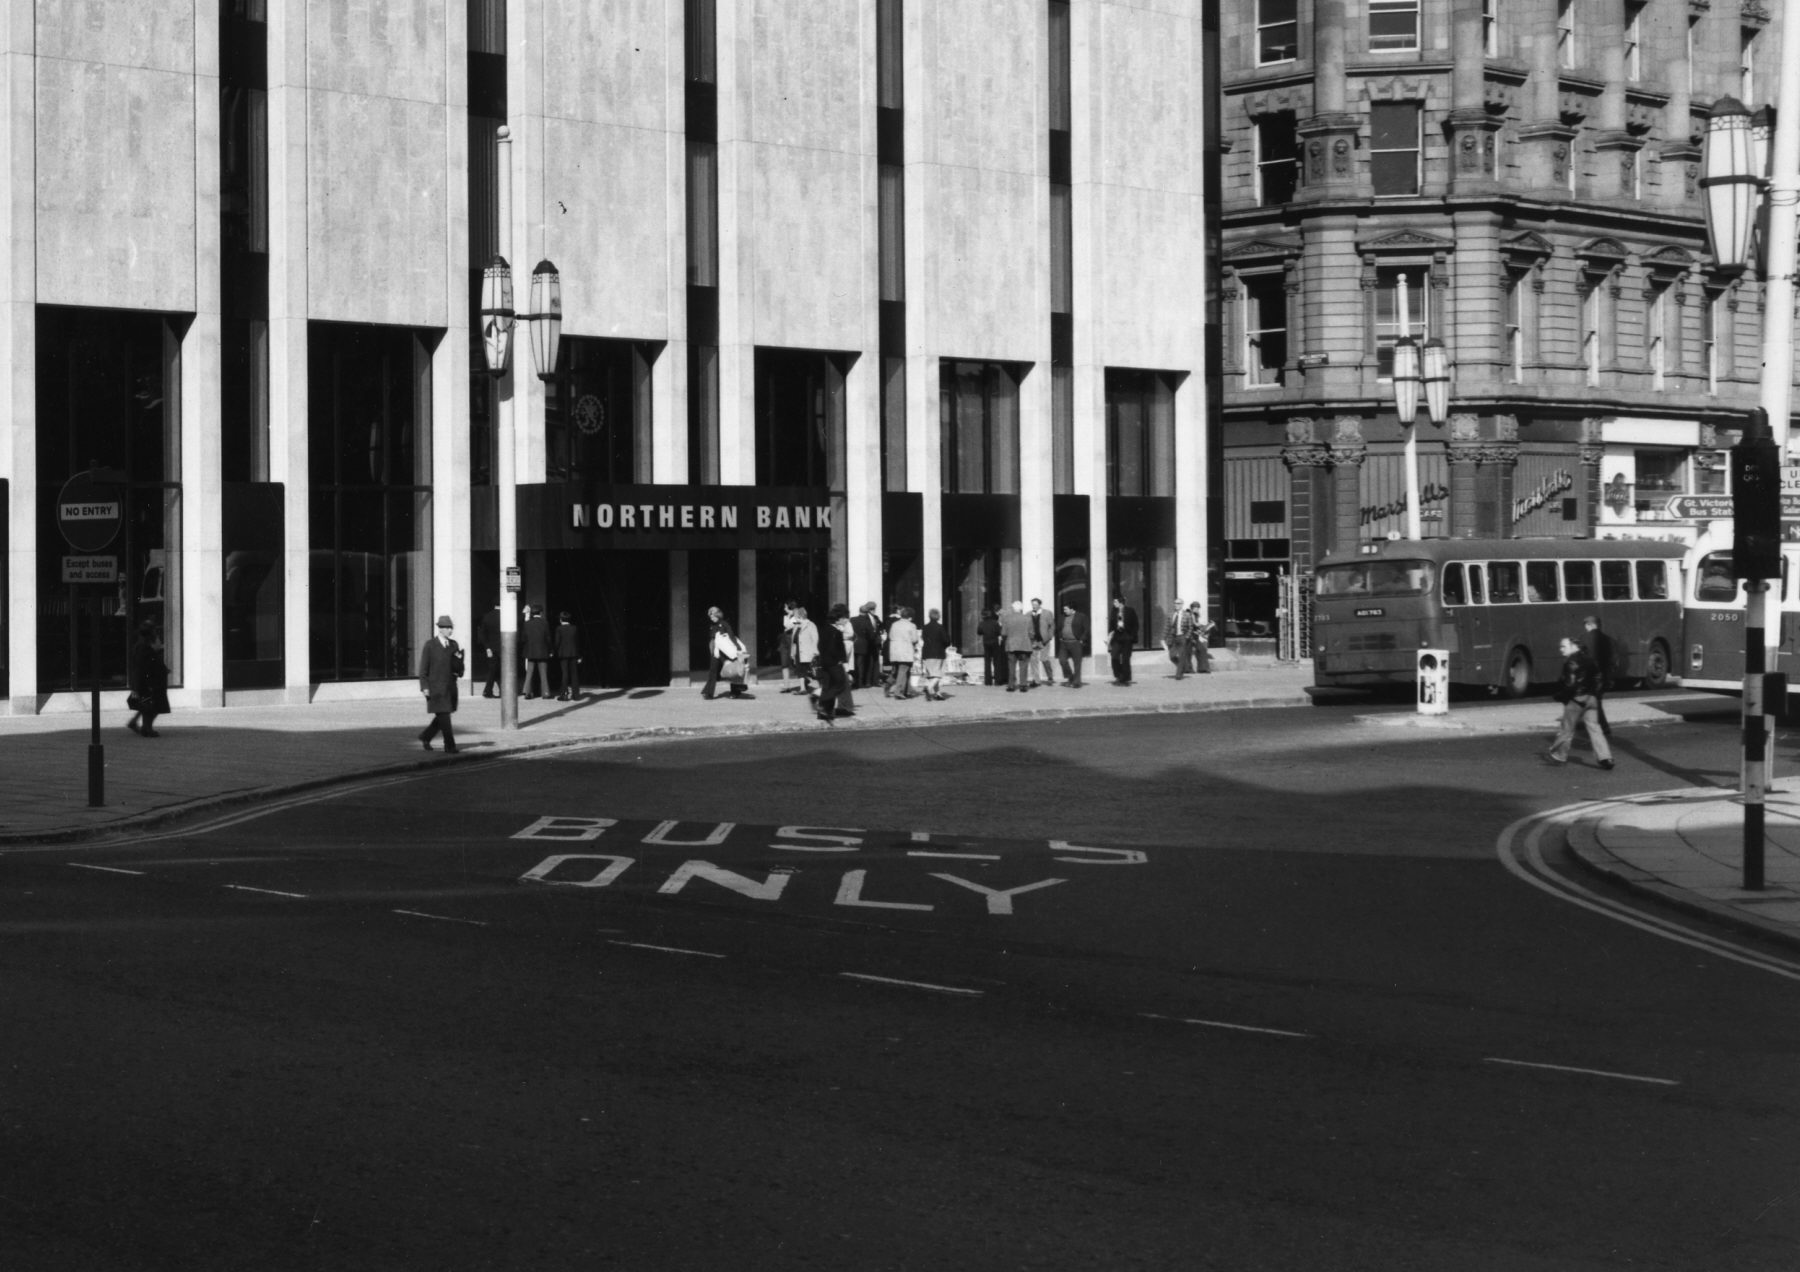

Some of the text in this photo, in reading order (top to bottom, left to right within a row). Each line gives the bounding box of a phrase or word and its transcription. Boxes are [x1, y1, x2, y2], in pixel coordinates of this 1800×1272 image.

[1360, 482, 1448, 526] Marslls
[66, 506, 112, 516] NO ENTRY
[572, 503, 832, 528] NORTHERN BANK
[1690, 508, 1707, 516] Bus
[66, 559, 112, 568] Except buses
[1711, 613, 1738, 621] 2050
[518, 854, 1070, 915] ONLY
